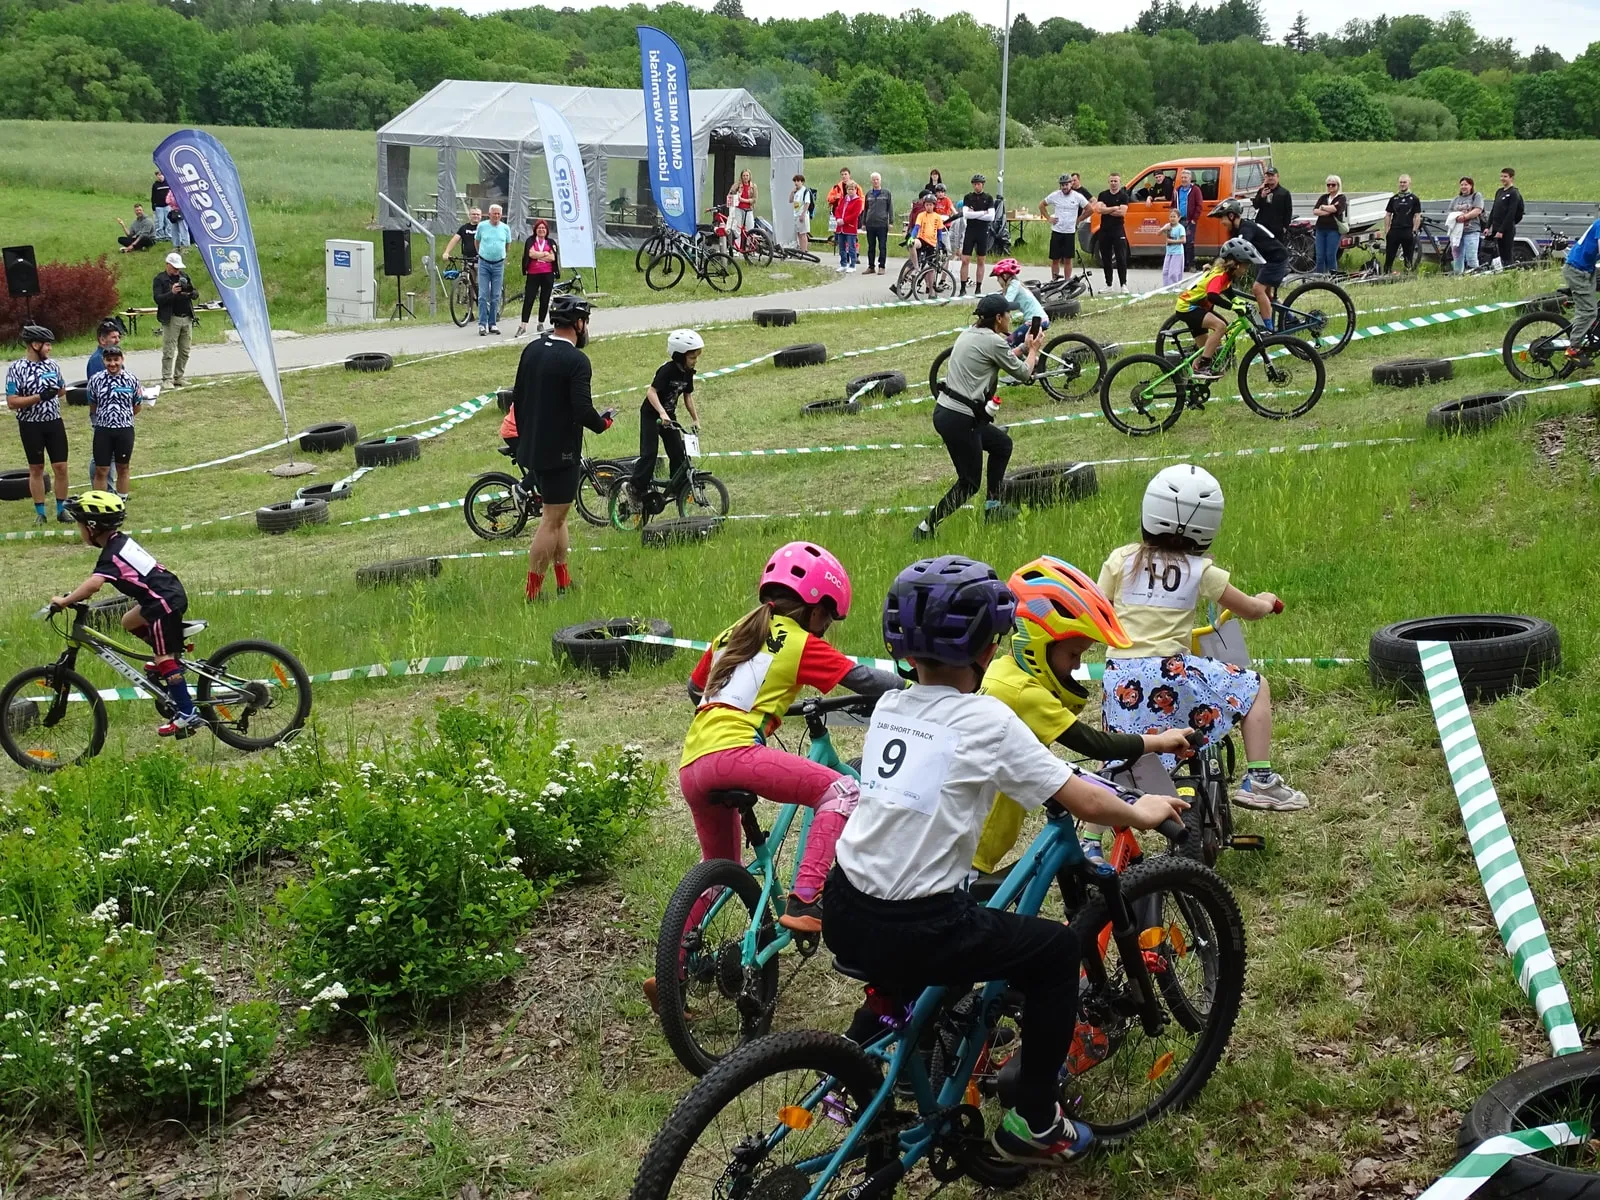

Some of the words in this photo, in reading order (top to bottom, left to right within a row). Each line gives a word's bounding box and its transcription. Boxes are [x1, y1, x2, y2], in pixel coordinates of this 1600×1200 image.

[1144, 563, 1182, 593] 10
[97, 647, 147, 690] GIANT
[889, 724, 912, 735] SHORT
[912, 729, 935, 740] TRACK
[877, 738, 907, 779] 9
